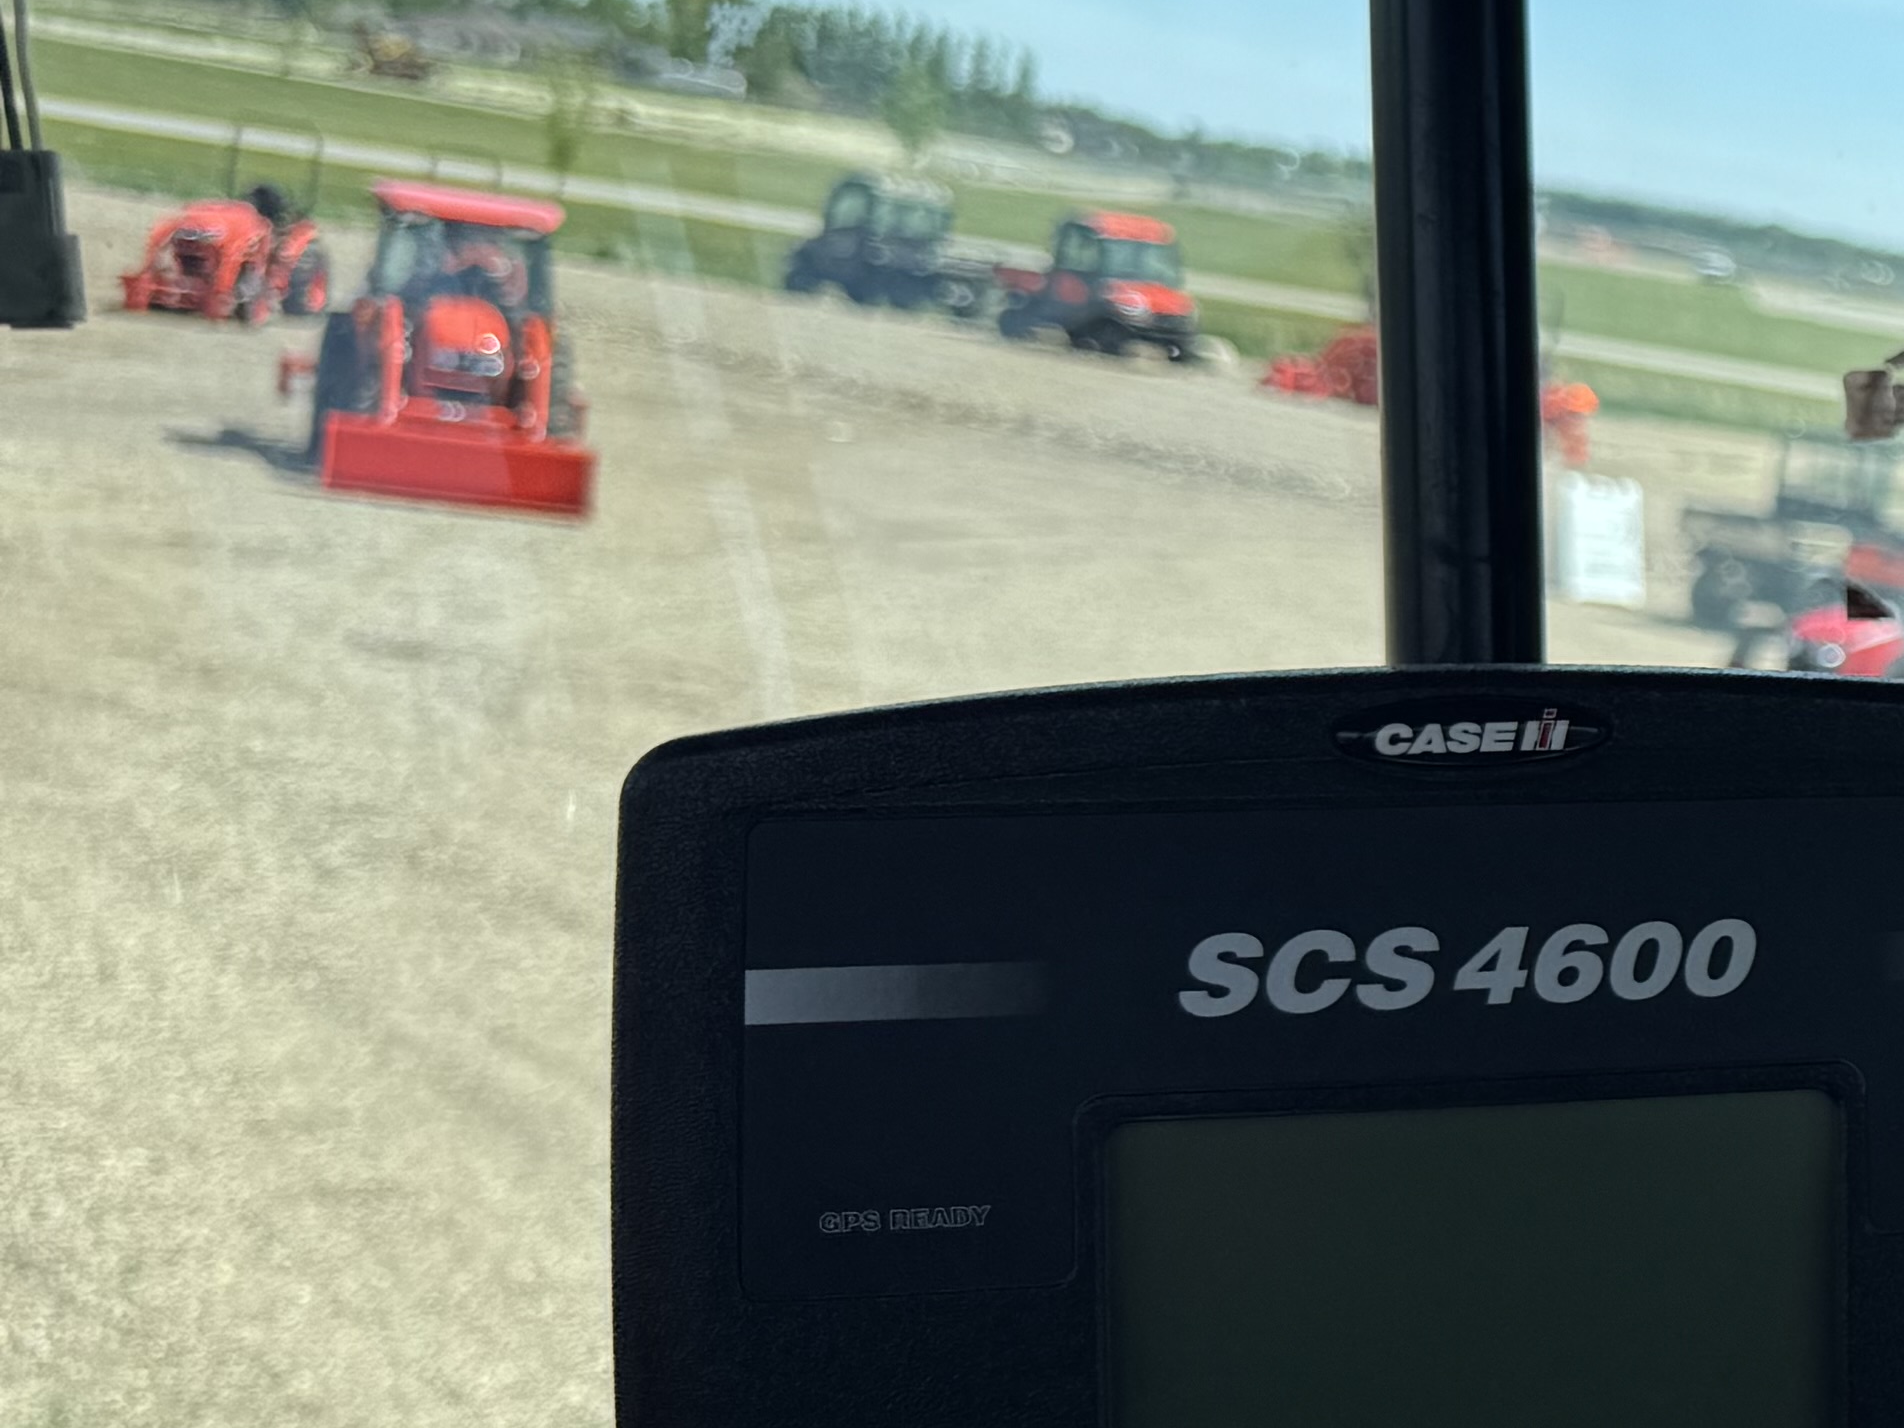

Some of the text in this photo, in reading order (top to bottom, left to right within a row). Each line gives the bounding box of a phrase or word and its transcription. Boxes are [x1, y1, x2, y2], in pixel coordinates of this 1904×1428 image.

[1374, 721, 1518, 756] CASE
[1178, 918, 1758, 1019] SCS 4600
[819, 1204, 993, 1234] GPS READY
